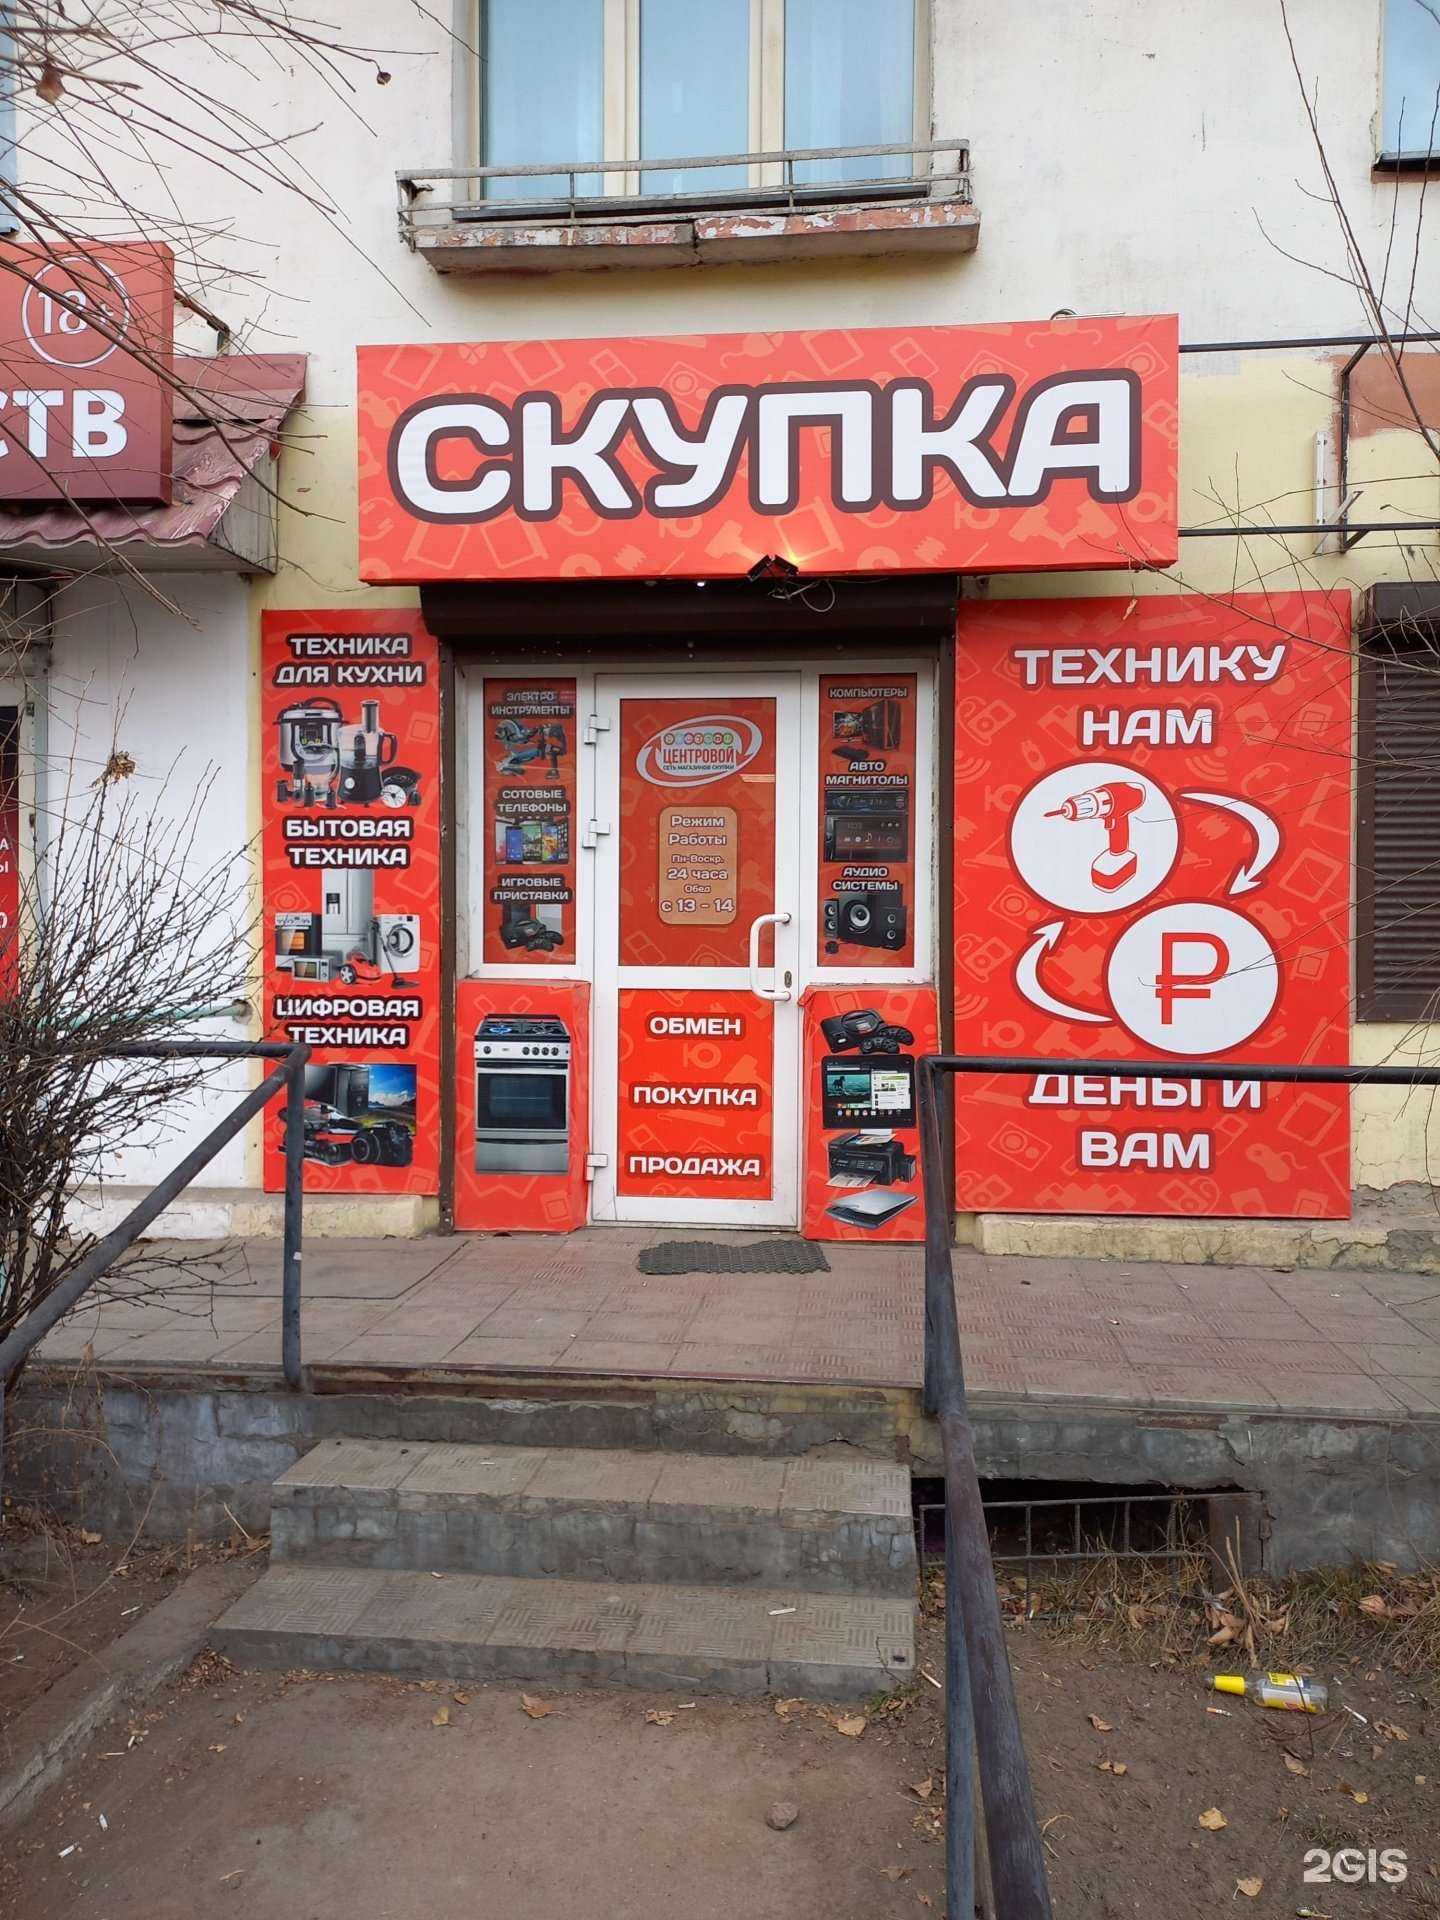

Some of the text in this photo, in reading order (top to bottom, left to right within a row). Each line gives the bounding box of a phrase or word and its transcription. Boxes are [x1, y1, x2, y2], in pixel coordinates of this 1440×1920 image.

[0, 388, 128, 459] ТВ
[397, 378, 1132, 516] СКУПКА
[290, 637, 409, 655] ТЕХНИКА
[1014, 644, 1286, 685] ТЕХНИКУ
[276, 665, 424, 684] ДЛЯ КУХНИ
[506, 691, 554, 702] ЭЛЕКТРО
[829, 687, 907, 698] КОМПЬЮТЕРЫ
[491, 705, 570, 715] ИНСТРУМЕНТЫ
[1082, 708, 1213, 745] НАМ
[663, 746, 735, 765] ЦЕНТРОВОЙ
[849, 761, 885, 771] АВТО
[826, 775, 908, 785] МАГНИТОЛЫ
[502, 789, 562, 799] СОТОВЫЕ
[497, 803, 567, 813] ТЕЛЕФОНЫ
[286, 819, 411, 838] БЫТОВАЯ
[671, 815, 725, 827] Режим
[668, 833, 727, 845] Работы
[289, 847, 407, 865] ТЕХНИКА
[667, 868, 728, 880] 24 часа
[843, 867, 888, 877] АУДИО
[501, 877, 562, 887] ИГРОВЫЕ
[832, 881, 898, 891] СИСТЕМЫ
[494, 891, 569, 901] ПРИСТАВКИ
[677, 899, 696, 912] 13
[714, 899, 734, 912] 14
[276, 999, 419, 1018] ЦИФРОВАЯ
[649, 1016, 741, 1036] ОБМЕН
[288, 1026, 406, 1045] ТЕХНИКА
[633, 1086, 757, 1106] ПОКУПКА
[1080, 1130, 1210, 1169] ВАМ
[629, 1156, 761, 1176] ПРОДАЖА
